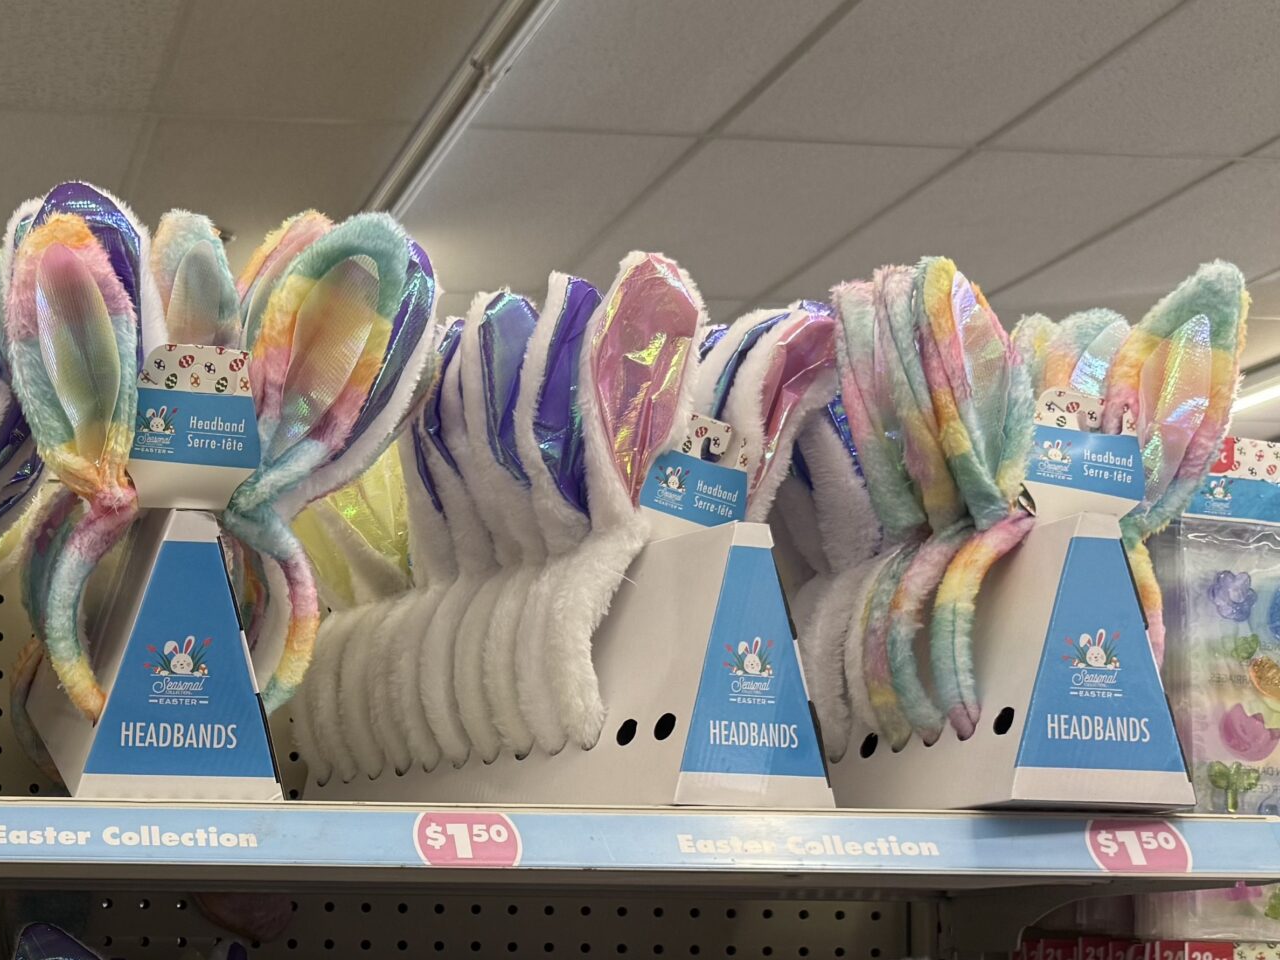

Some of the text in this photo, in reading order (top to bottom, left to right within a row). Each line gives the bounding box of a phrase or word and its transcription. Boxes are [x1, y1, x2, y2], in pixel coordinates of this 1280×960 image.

[189, 416, 245, 433] Headband
[187, 434, 243, 451] Serre-tête
[1083, 449, 1134, 467] Headband
[1083, 464, 1132, 484] Serre-tête
[696, 480, 738, 503] Headband
[693, 496, 733, 518] Serre-tête
[152, 677, 206, 694] Seasonal
[731, 677, 771, 693] Seasonal
[1072, 669, 1118, 686] Seasonal
[737, 696, 766, 705] EASTER
[1079, 690, 1113, 698] EASTER
[120, 721, 237, 749] HEADBANDS
[709, 720, 798, 748] HEADBANDS
[1047, 714, 1151, 743] HEADBANDS
[102, 825, 258, 848] Collection
[677, 833, 940, 857] Easter Collection
